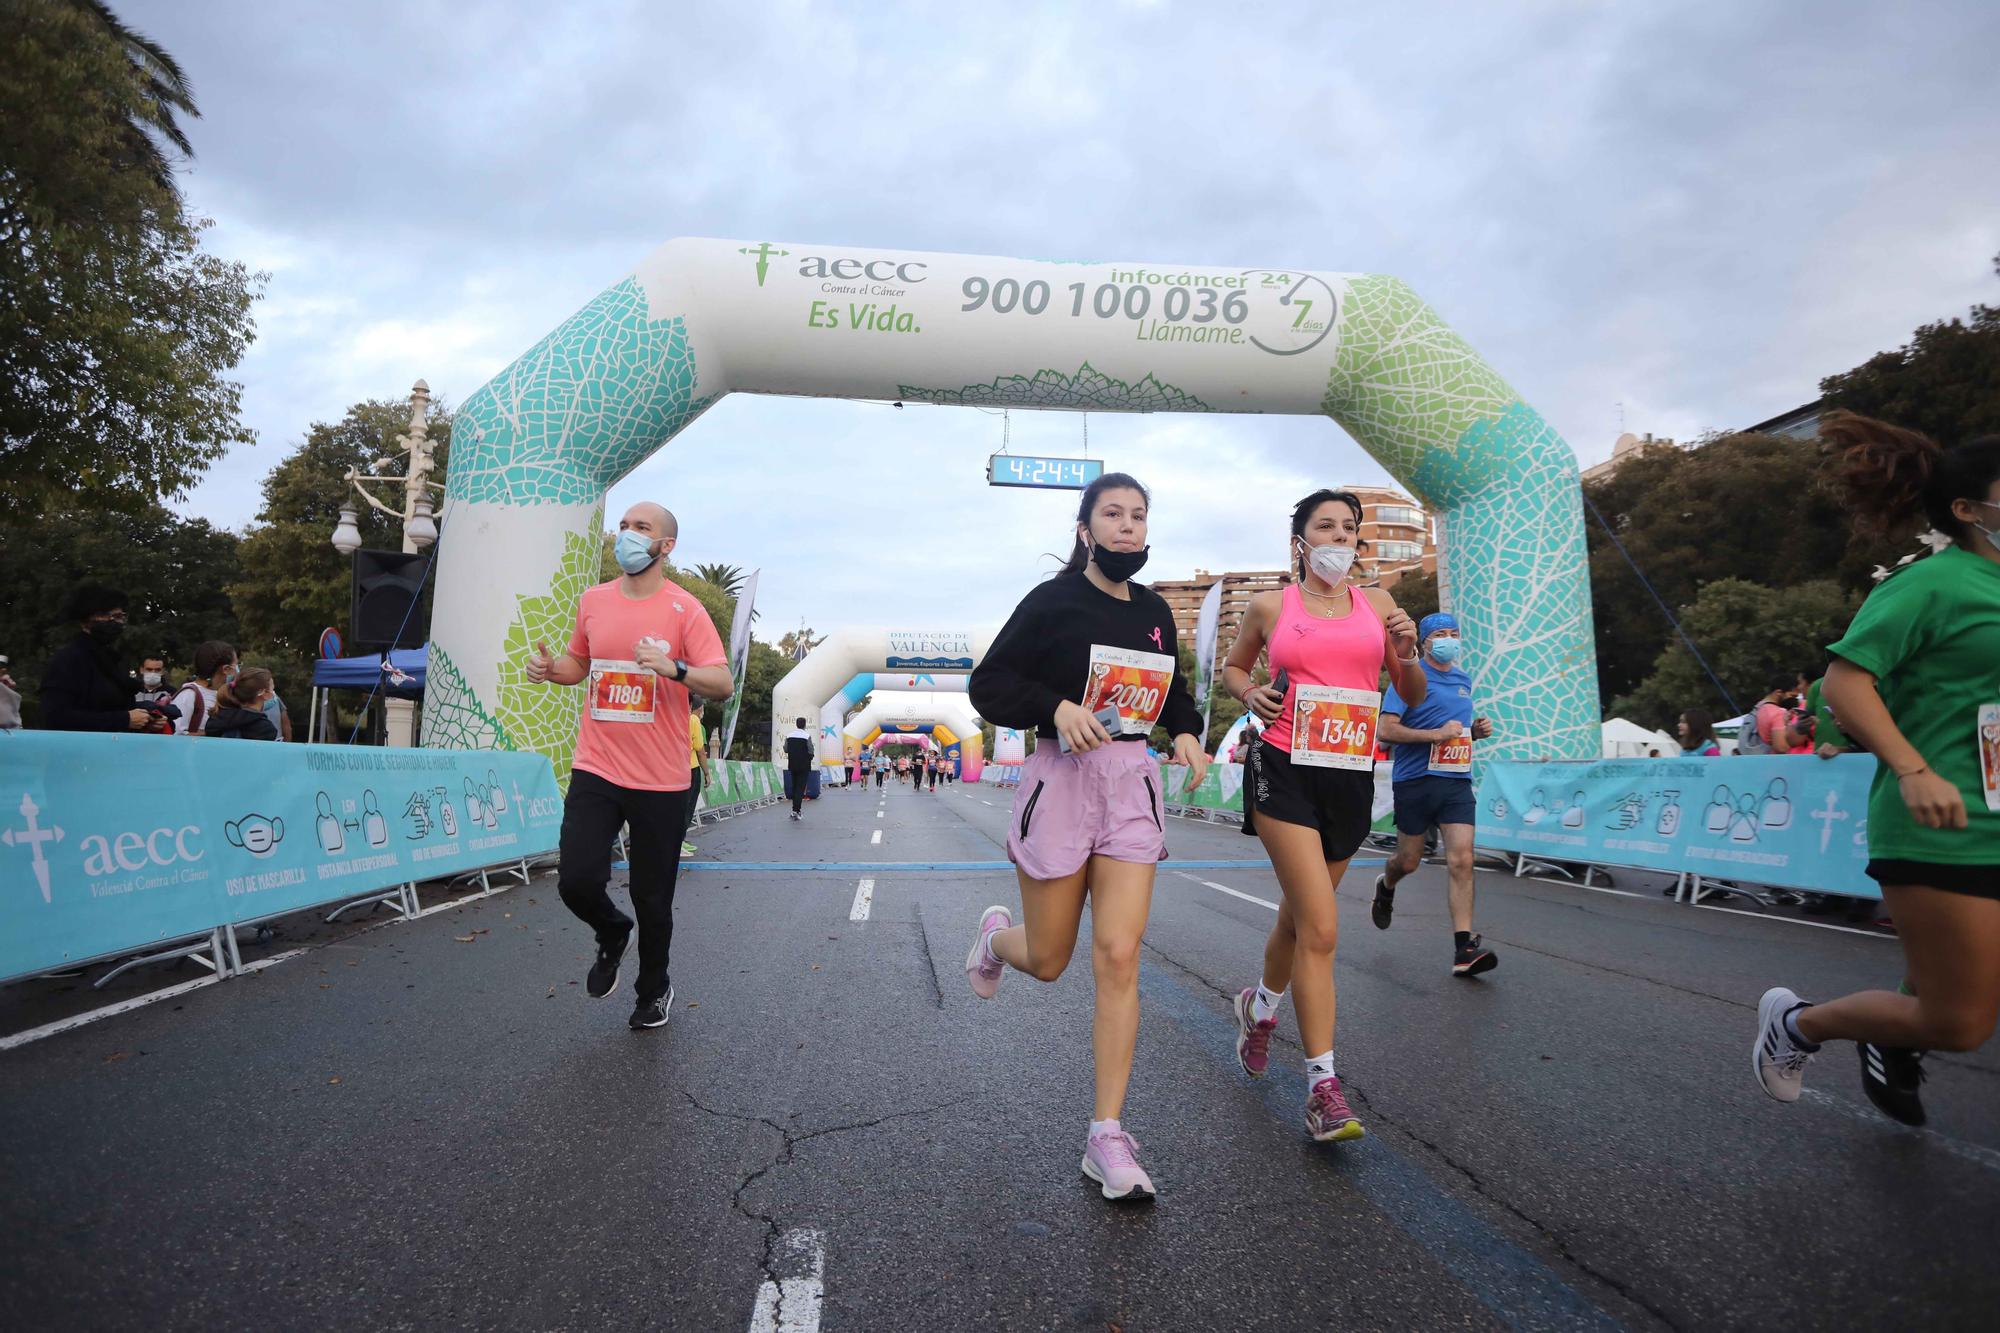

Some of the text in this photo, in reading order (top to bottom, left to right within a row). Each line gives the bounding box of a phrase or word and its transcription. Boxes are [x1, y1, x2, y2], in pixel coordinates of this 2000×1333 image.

[799, 256, 928, 283] aecc
[1110, 268, 1248, 290] infocáncer
[1261, 272, 1291, 285] 24
[821, 282, 906, 297] Contra el Cáncer
[960, 276, 1249, 324] 900 100 036
[808, 300, 921, 333] Es Vida.
[1292, 300, 1313, 328] 7
[1136, 317, 1246, 345] Llámame.
[608, 684, 643, 705] 1180
[1103, 683, 1159, 714] 2000
[1321, 718, 1368, 747] 1346
[306, 751, 346, 771] NORMAS
[346, 753, 373, 770] COVID
[374, 753, 386, 770] DE
[1443, 745, 1470, 760] 2073
[80, 824, 205, 876] aecc
[225, 868, 307, 897] USO DE MASCARILLA
